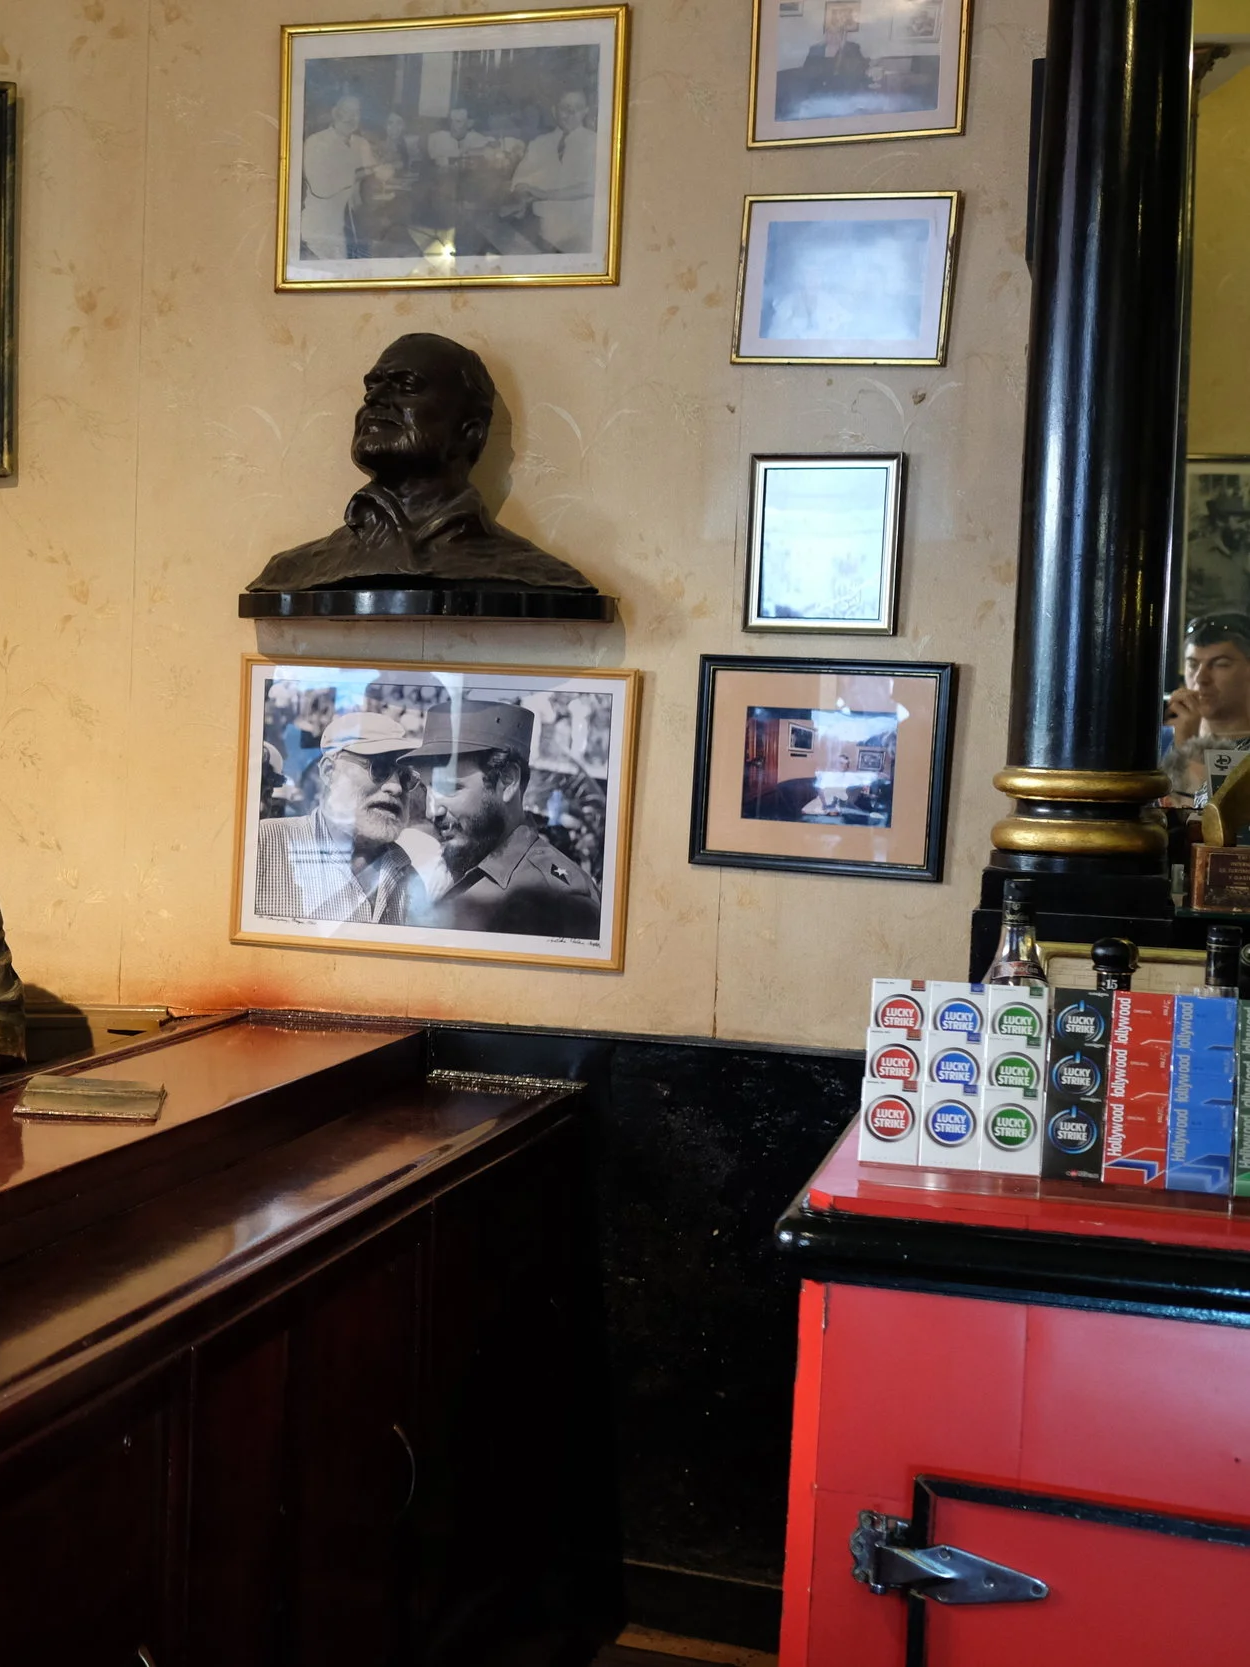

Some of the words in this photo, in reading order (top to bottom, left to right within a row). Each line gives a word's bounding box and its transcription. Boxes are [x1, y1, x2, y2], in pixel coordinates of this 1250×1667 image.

[1105, 979, 1118, 990] 15
[885, 1008, 914, 1017] LUCKY
[944, 1011, 974, 1021] LUCKY
[883, 1017, 914, 1027] STRIKE
[1003, 1015, 1033, 1025] LUCKY
[1068, 1015, 1095, 1024] LUCKY
[1114, 996, 1132, 1044] ollywood
[1176, 1001, 1194, 1049] ollywood
[942, 1020, 974, 1031] STRIKE
[1001, 1024, 1033, 1035] STRIKE
[1065, 1024, 1095, 1034] STRIKE
[881, 1057, 910, 1067] LUCKY
[940, 1061, 970, 1071] LUCKY
[878, 1066, 910, 1077] STRIKE
[938, 1070, 970, 1081] STRIKE
[1000, 1065, 1030, 1076] LUCKY
[1063, 1067, 1091, 1076] LUCKY
[998, 1075, 1030, 1086] STRIKE
[1061, 1076, 1091, 1086] STRIKE
[876, 1108, 905, 1119] LUCKY
[936, 1113, 966, 1124] LUCKY
[874, 1118, 905, 1129] STRIKE
[996, 1117, 1027, 1128] LUCKY
[1060, 1122, 1088, 1132] LUCKY
[934, 1123, 966, 1134] STRIKE
[994, 1127, 1027, 1138] STRIKE
[1107, 1104, 1126, 1157] Hollywood
[1057, 1131, 1088, 1141] STRIKE
[1170, 1108, 1190, 1162] Hollywood
